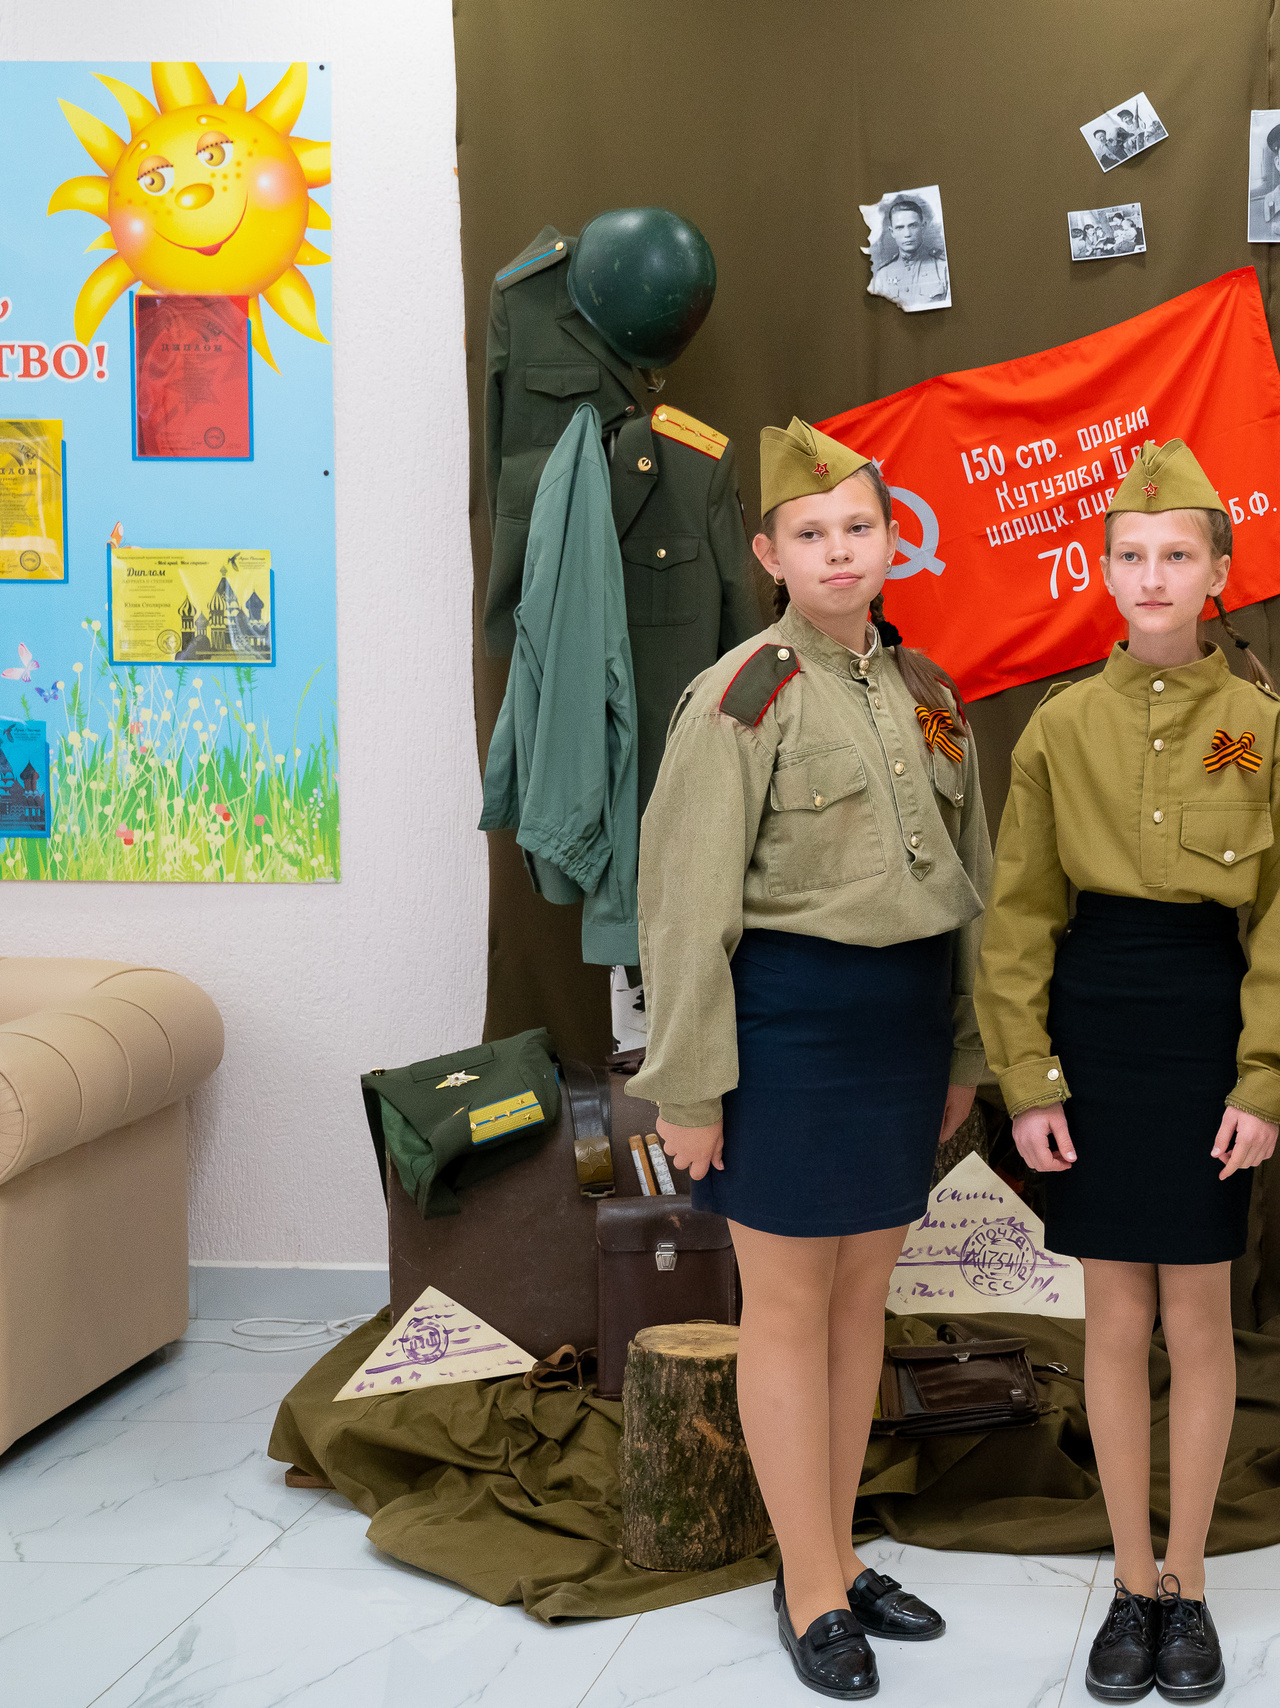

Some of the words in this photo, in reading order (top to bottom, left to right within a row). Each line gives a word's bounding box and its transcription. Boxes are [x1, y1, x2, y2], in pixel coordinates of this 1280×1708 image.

[960, 444, 1006, 485] 150
[126, 567, 166, 577] Диплом
[1037, 541, 1090, 600] 79
